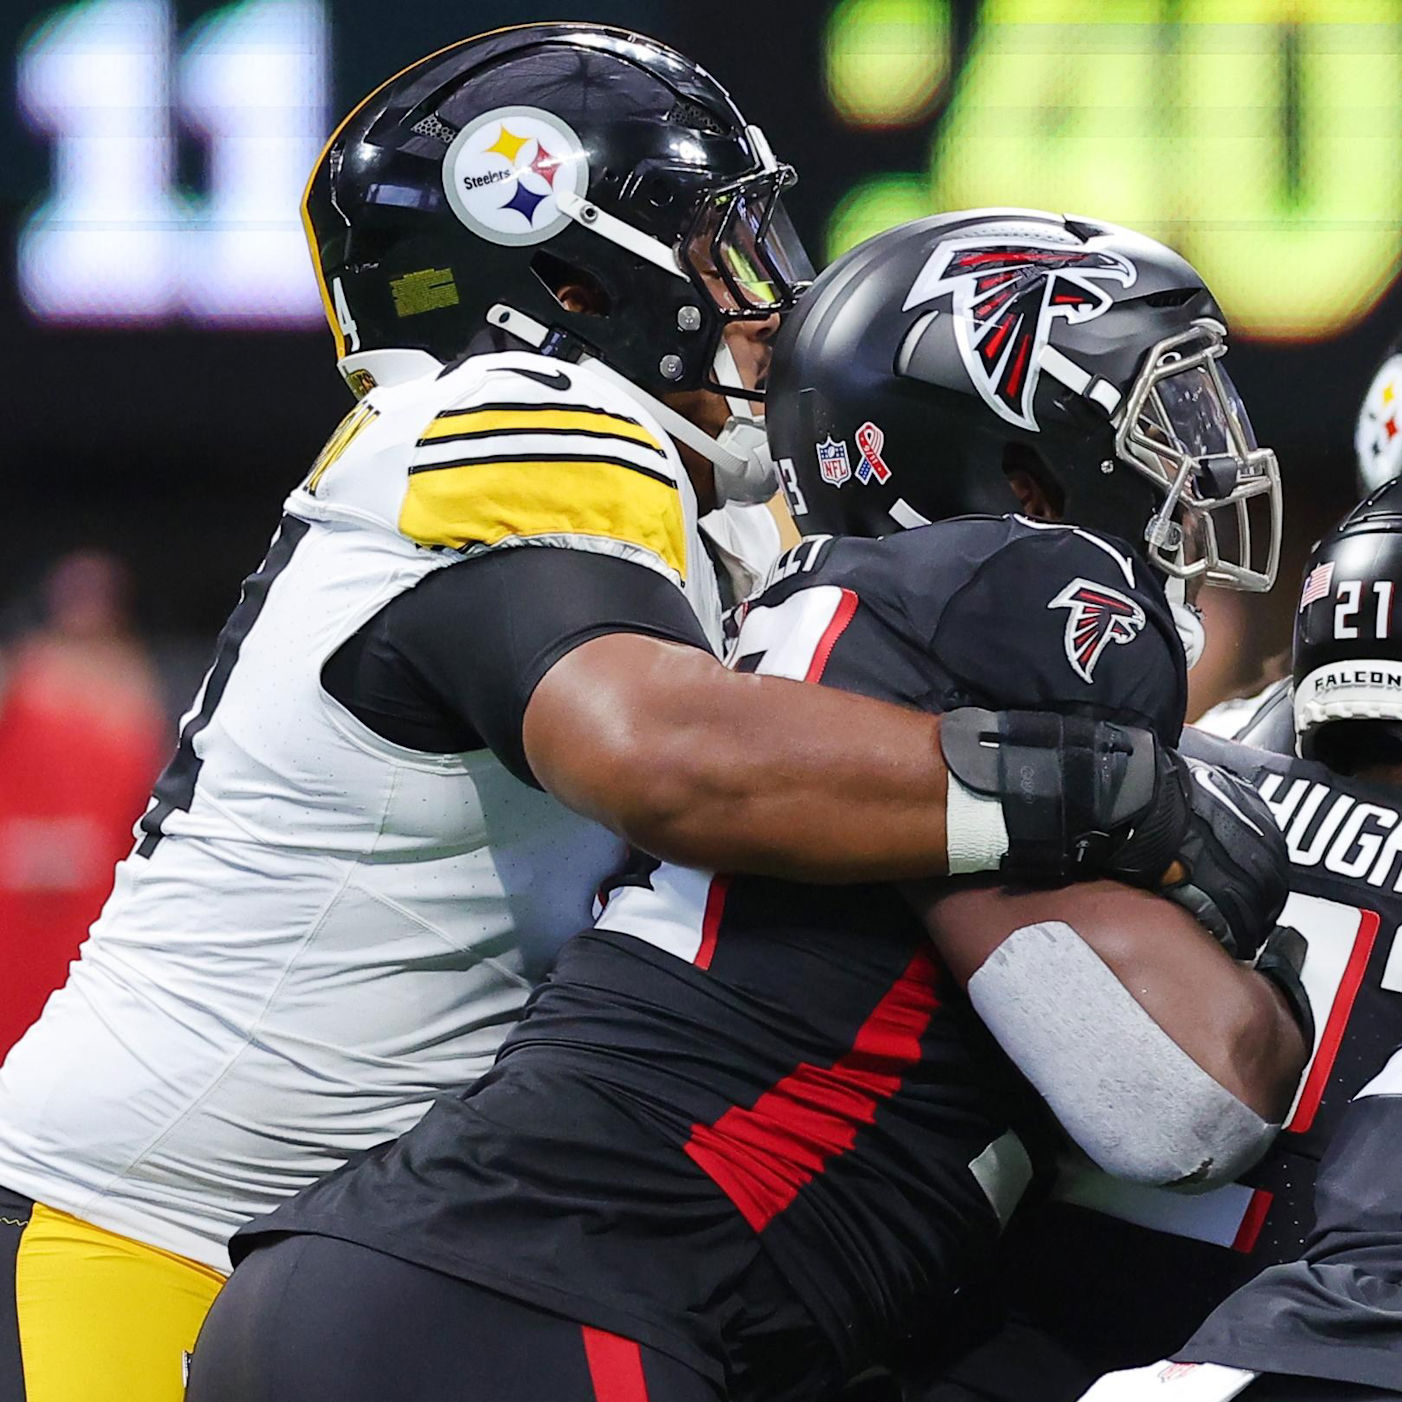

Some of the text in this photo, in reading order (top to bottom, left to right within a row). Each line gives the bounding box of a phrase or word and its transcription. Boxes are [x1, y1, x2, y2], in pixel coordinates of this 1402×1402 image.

[14, 0, 331, 324] 11
[463, 167, 511, 190] Steelers
[821, 459, 847, 479] NFL
[1334, 580, 1394, 640] 21
